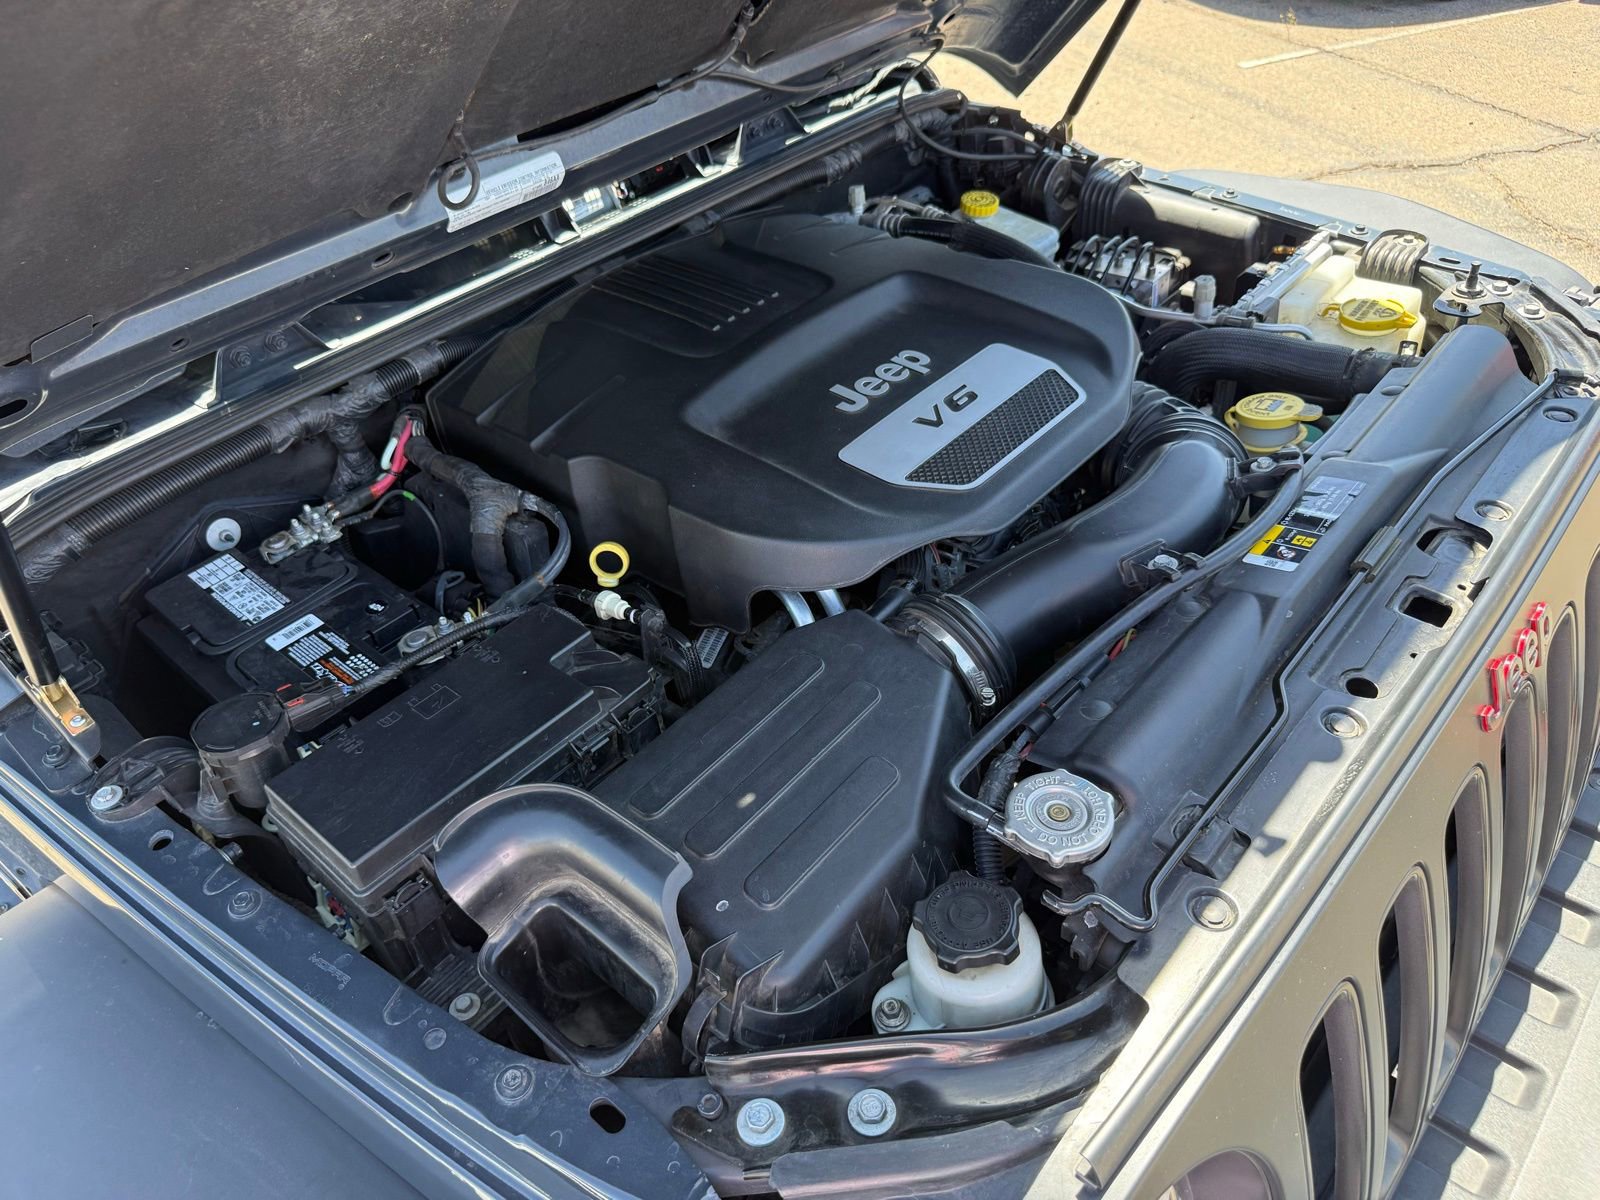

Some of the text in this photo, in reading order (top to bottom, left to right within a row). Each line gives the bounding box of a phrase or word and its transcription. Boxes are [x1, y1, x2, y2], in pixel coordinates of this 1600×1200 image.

[829, 349, 932, 414] Jeep
[912, 384, 979, 428] V6
[1479, 601, 1553, 733] Jeep
[1014, 775, 1061, 821] KEEP TIGHT
[1038, 786, 1107, 847] DO NOT OPEN HOT
